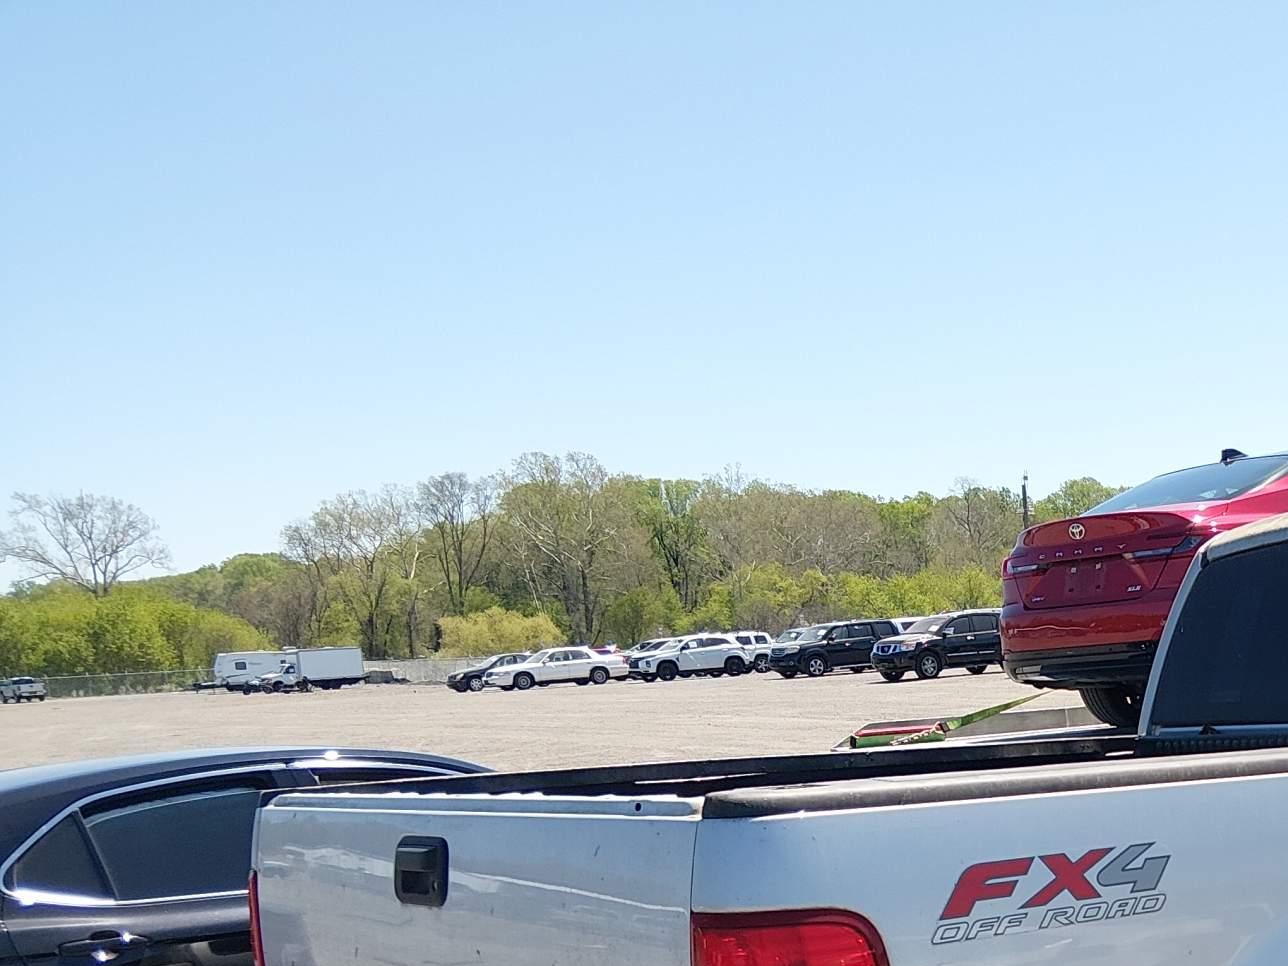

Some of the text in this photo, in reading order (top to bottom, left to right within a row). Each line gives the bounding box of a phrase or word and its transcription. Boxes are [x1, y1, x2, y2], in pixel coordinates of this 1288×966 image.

[938, 842, 1171, 921] FX4
[931, 893, 1167, 945] OFF ROAD
